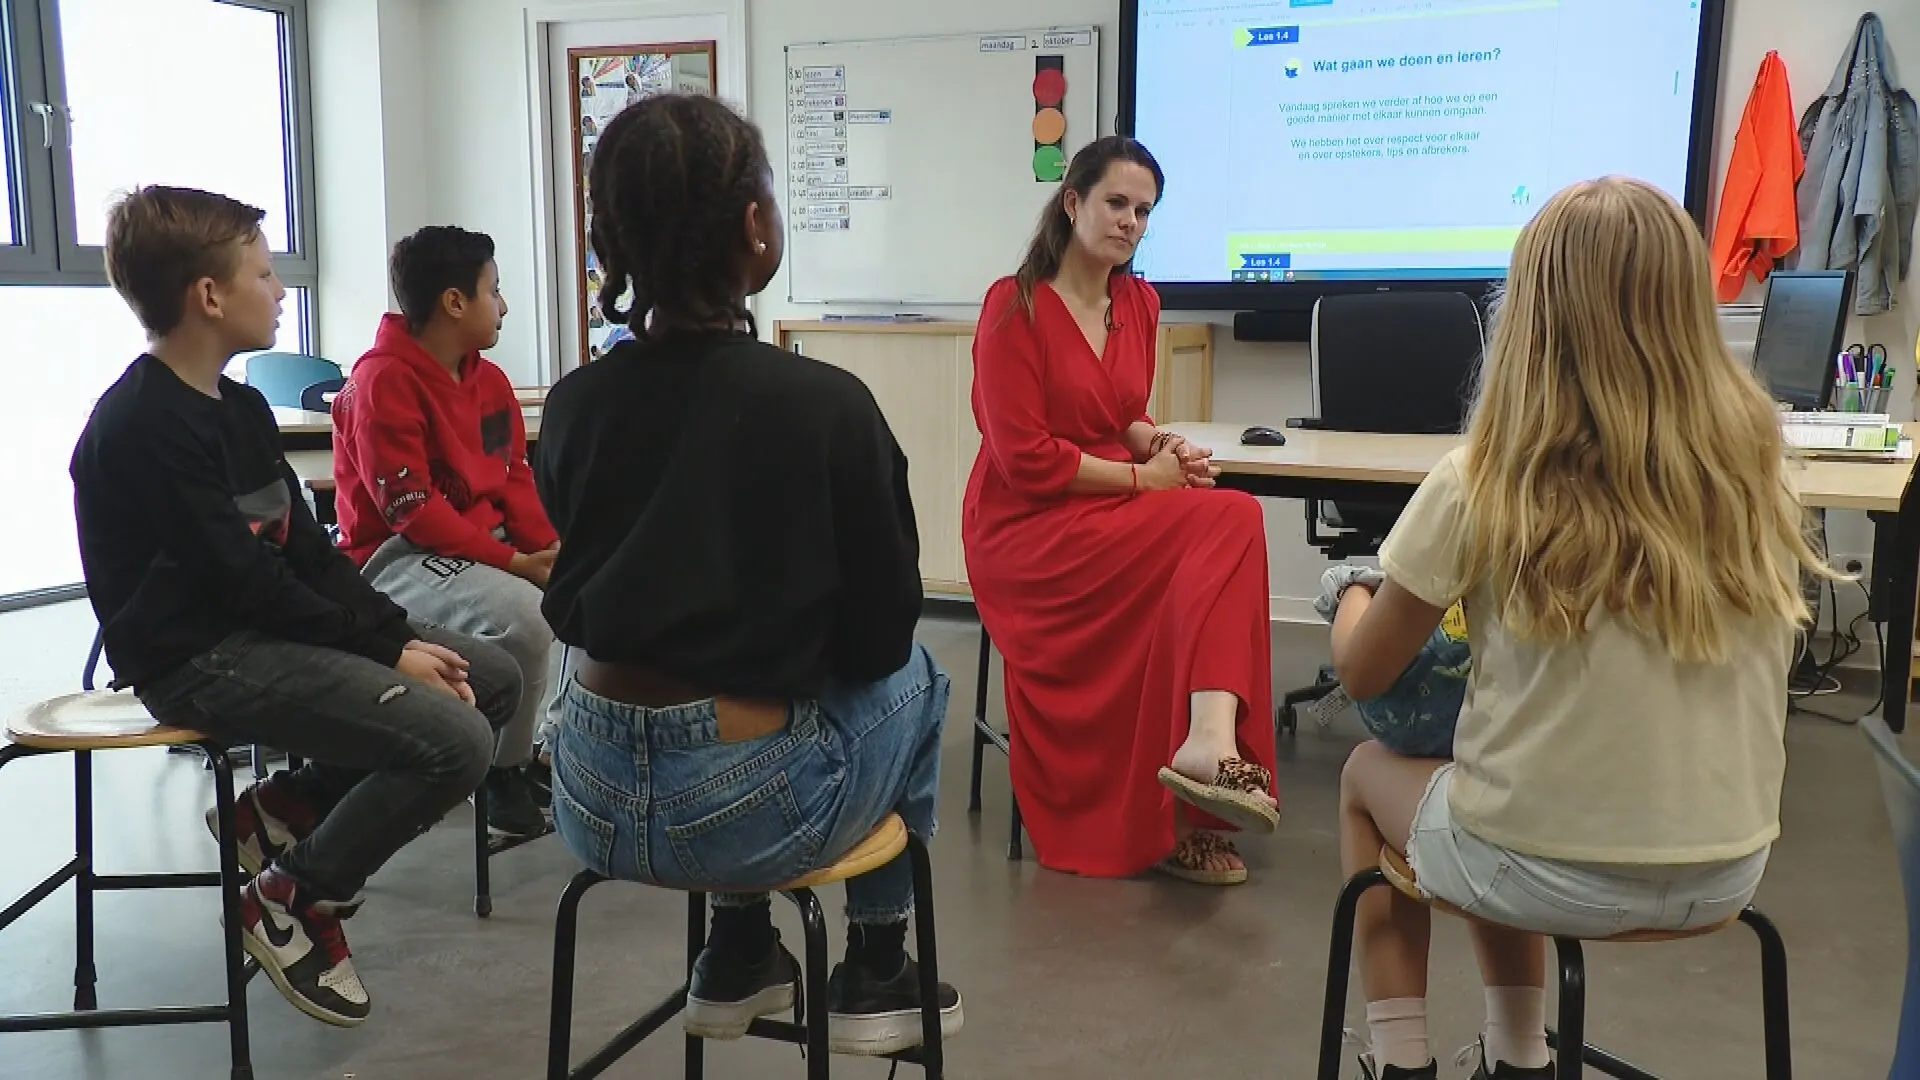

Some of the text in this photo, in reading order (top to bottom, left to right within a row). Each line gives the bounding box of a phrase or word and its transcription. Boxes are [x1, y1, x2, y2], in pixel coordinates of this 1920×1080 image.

[981, 41, 1015, 50] maandag
[1044, 37, 1074, 45] oktober
[1257, 31, 1289, 41] Les 1.4
[1313, 47, 1501, 73] Wat gaan we doen en leren?
[1278, 92, 1498, 113] Vandaag spreken we verder af hoe we op een
[1286, 106, 1487, 126] goede manier met elkaar kunnen omgaan.
[1290, 131, 1481, 148] We hebben het over respect voor elkaar
[1298, 151, 1310, 160] en
[1312, 150, 1333, 159] over
[1387, 146, 1404, 158] tips
[1406, 147, 1419, 156] en
[1250, 257, 1281, 267] Les 1.4
